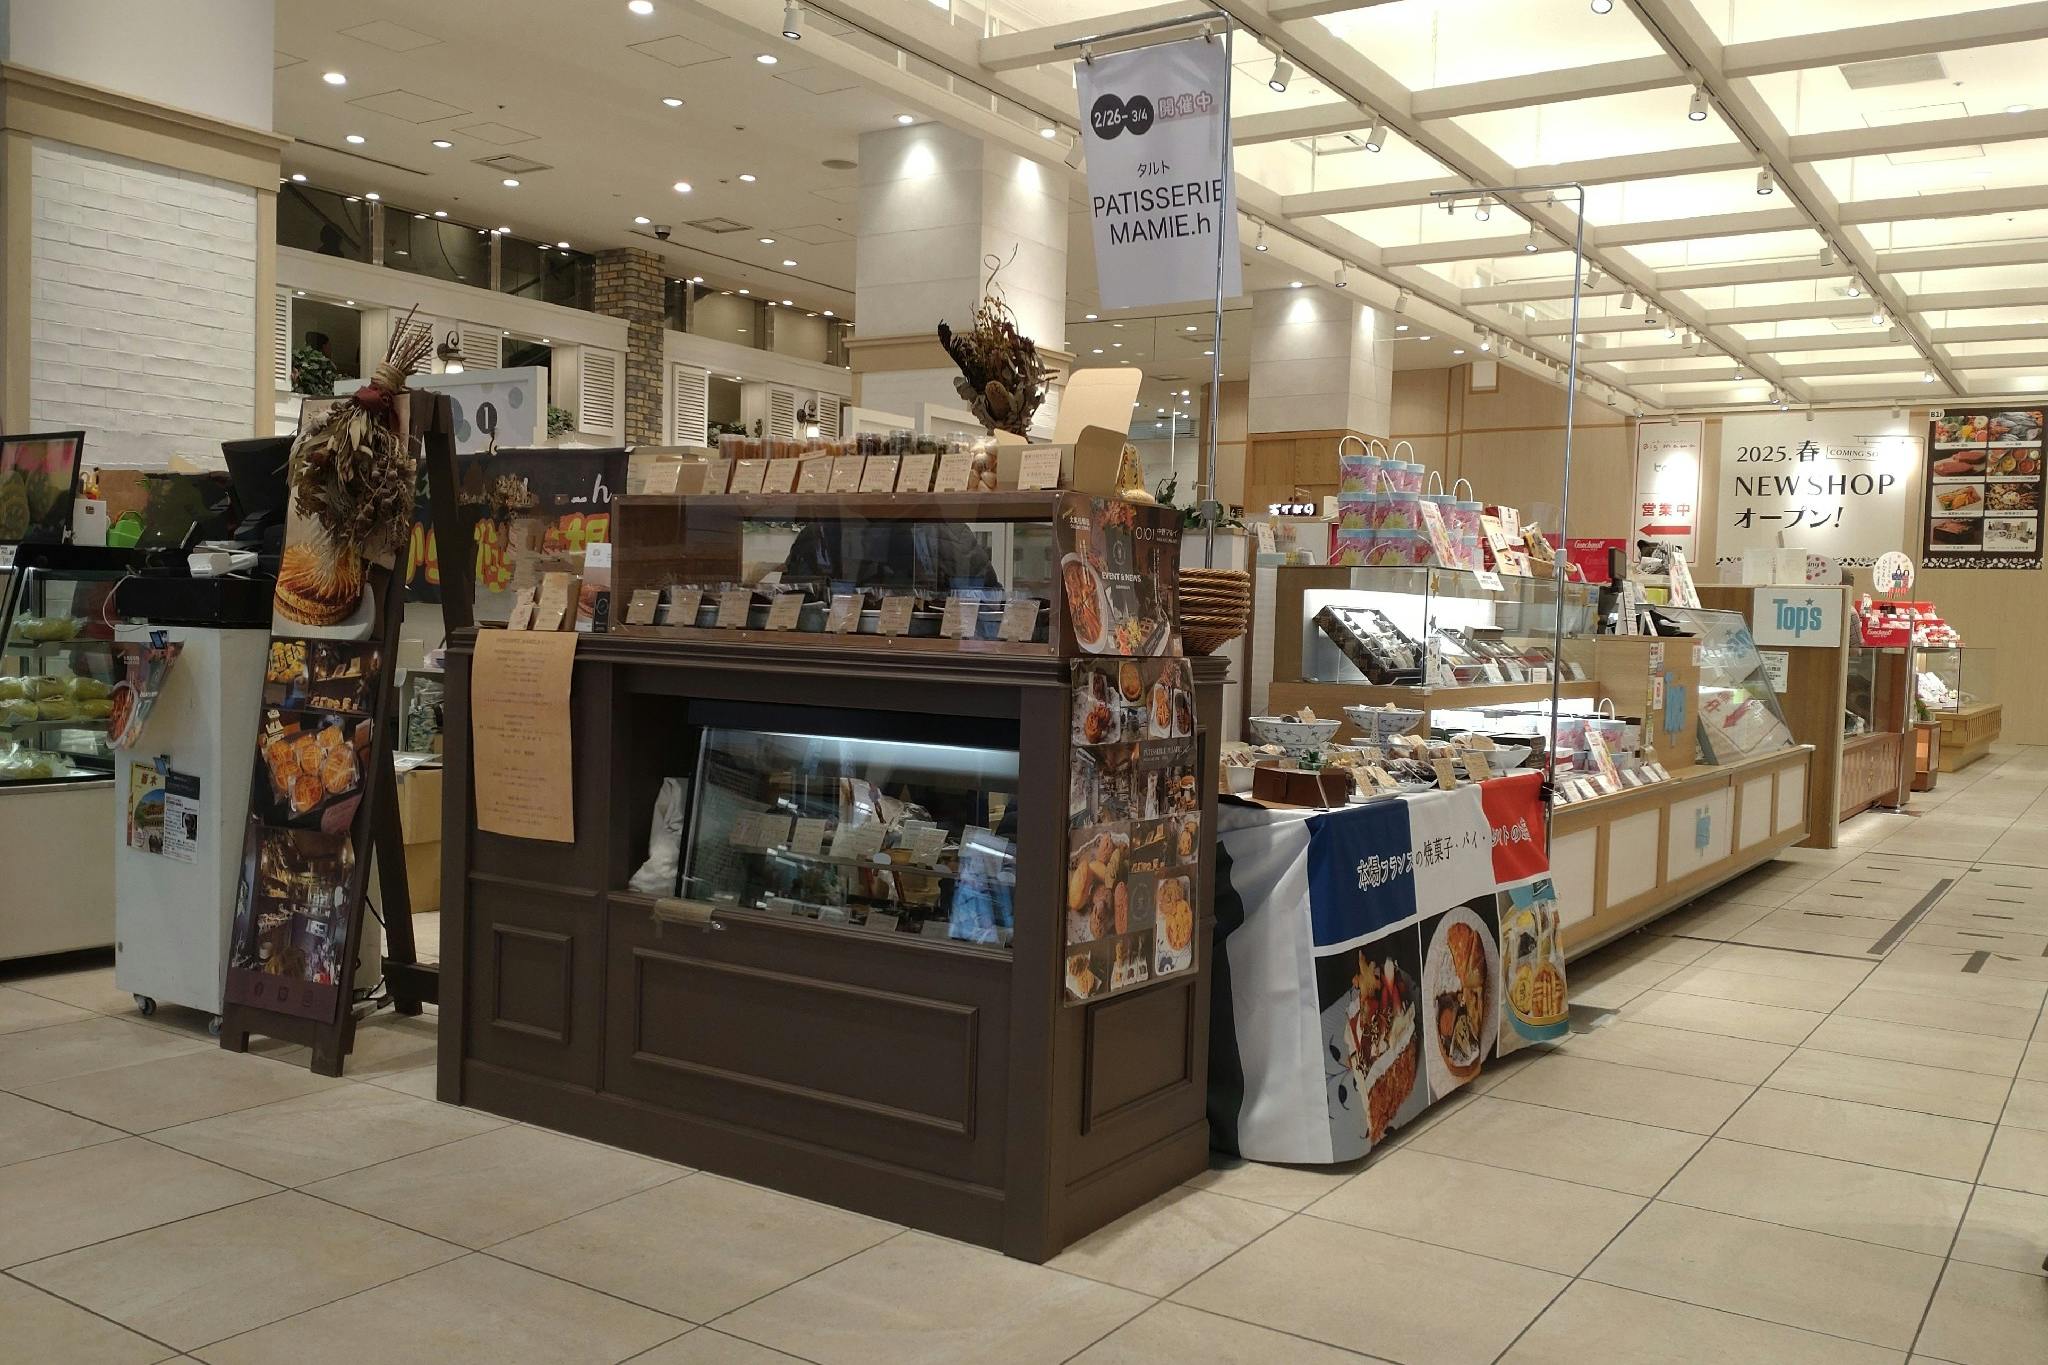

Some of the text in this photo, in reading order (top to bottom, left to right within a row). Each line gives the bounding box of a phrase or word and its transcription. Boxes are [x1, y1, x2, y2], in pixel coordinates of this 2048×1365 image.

[1158, 91, 1213, 120] 開催中
[1137, 160, 1170, 178] タルト
[1093, 179, 1223, 218] PATISSERIE
[1110, 212, 1211, 246] MAMIE.h
[1829, 449, 1864, 458] COMING
[1735, 473, 1895, 497] NEW SHOP
[1642, 502, 1690, 517] 営業中
